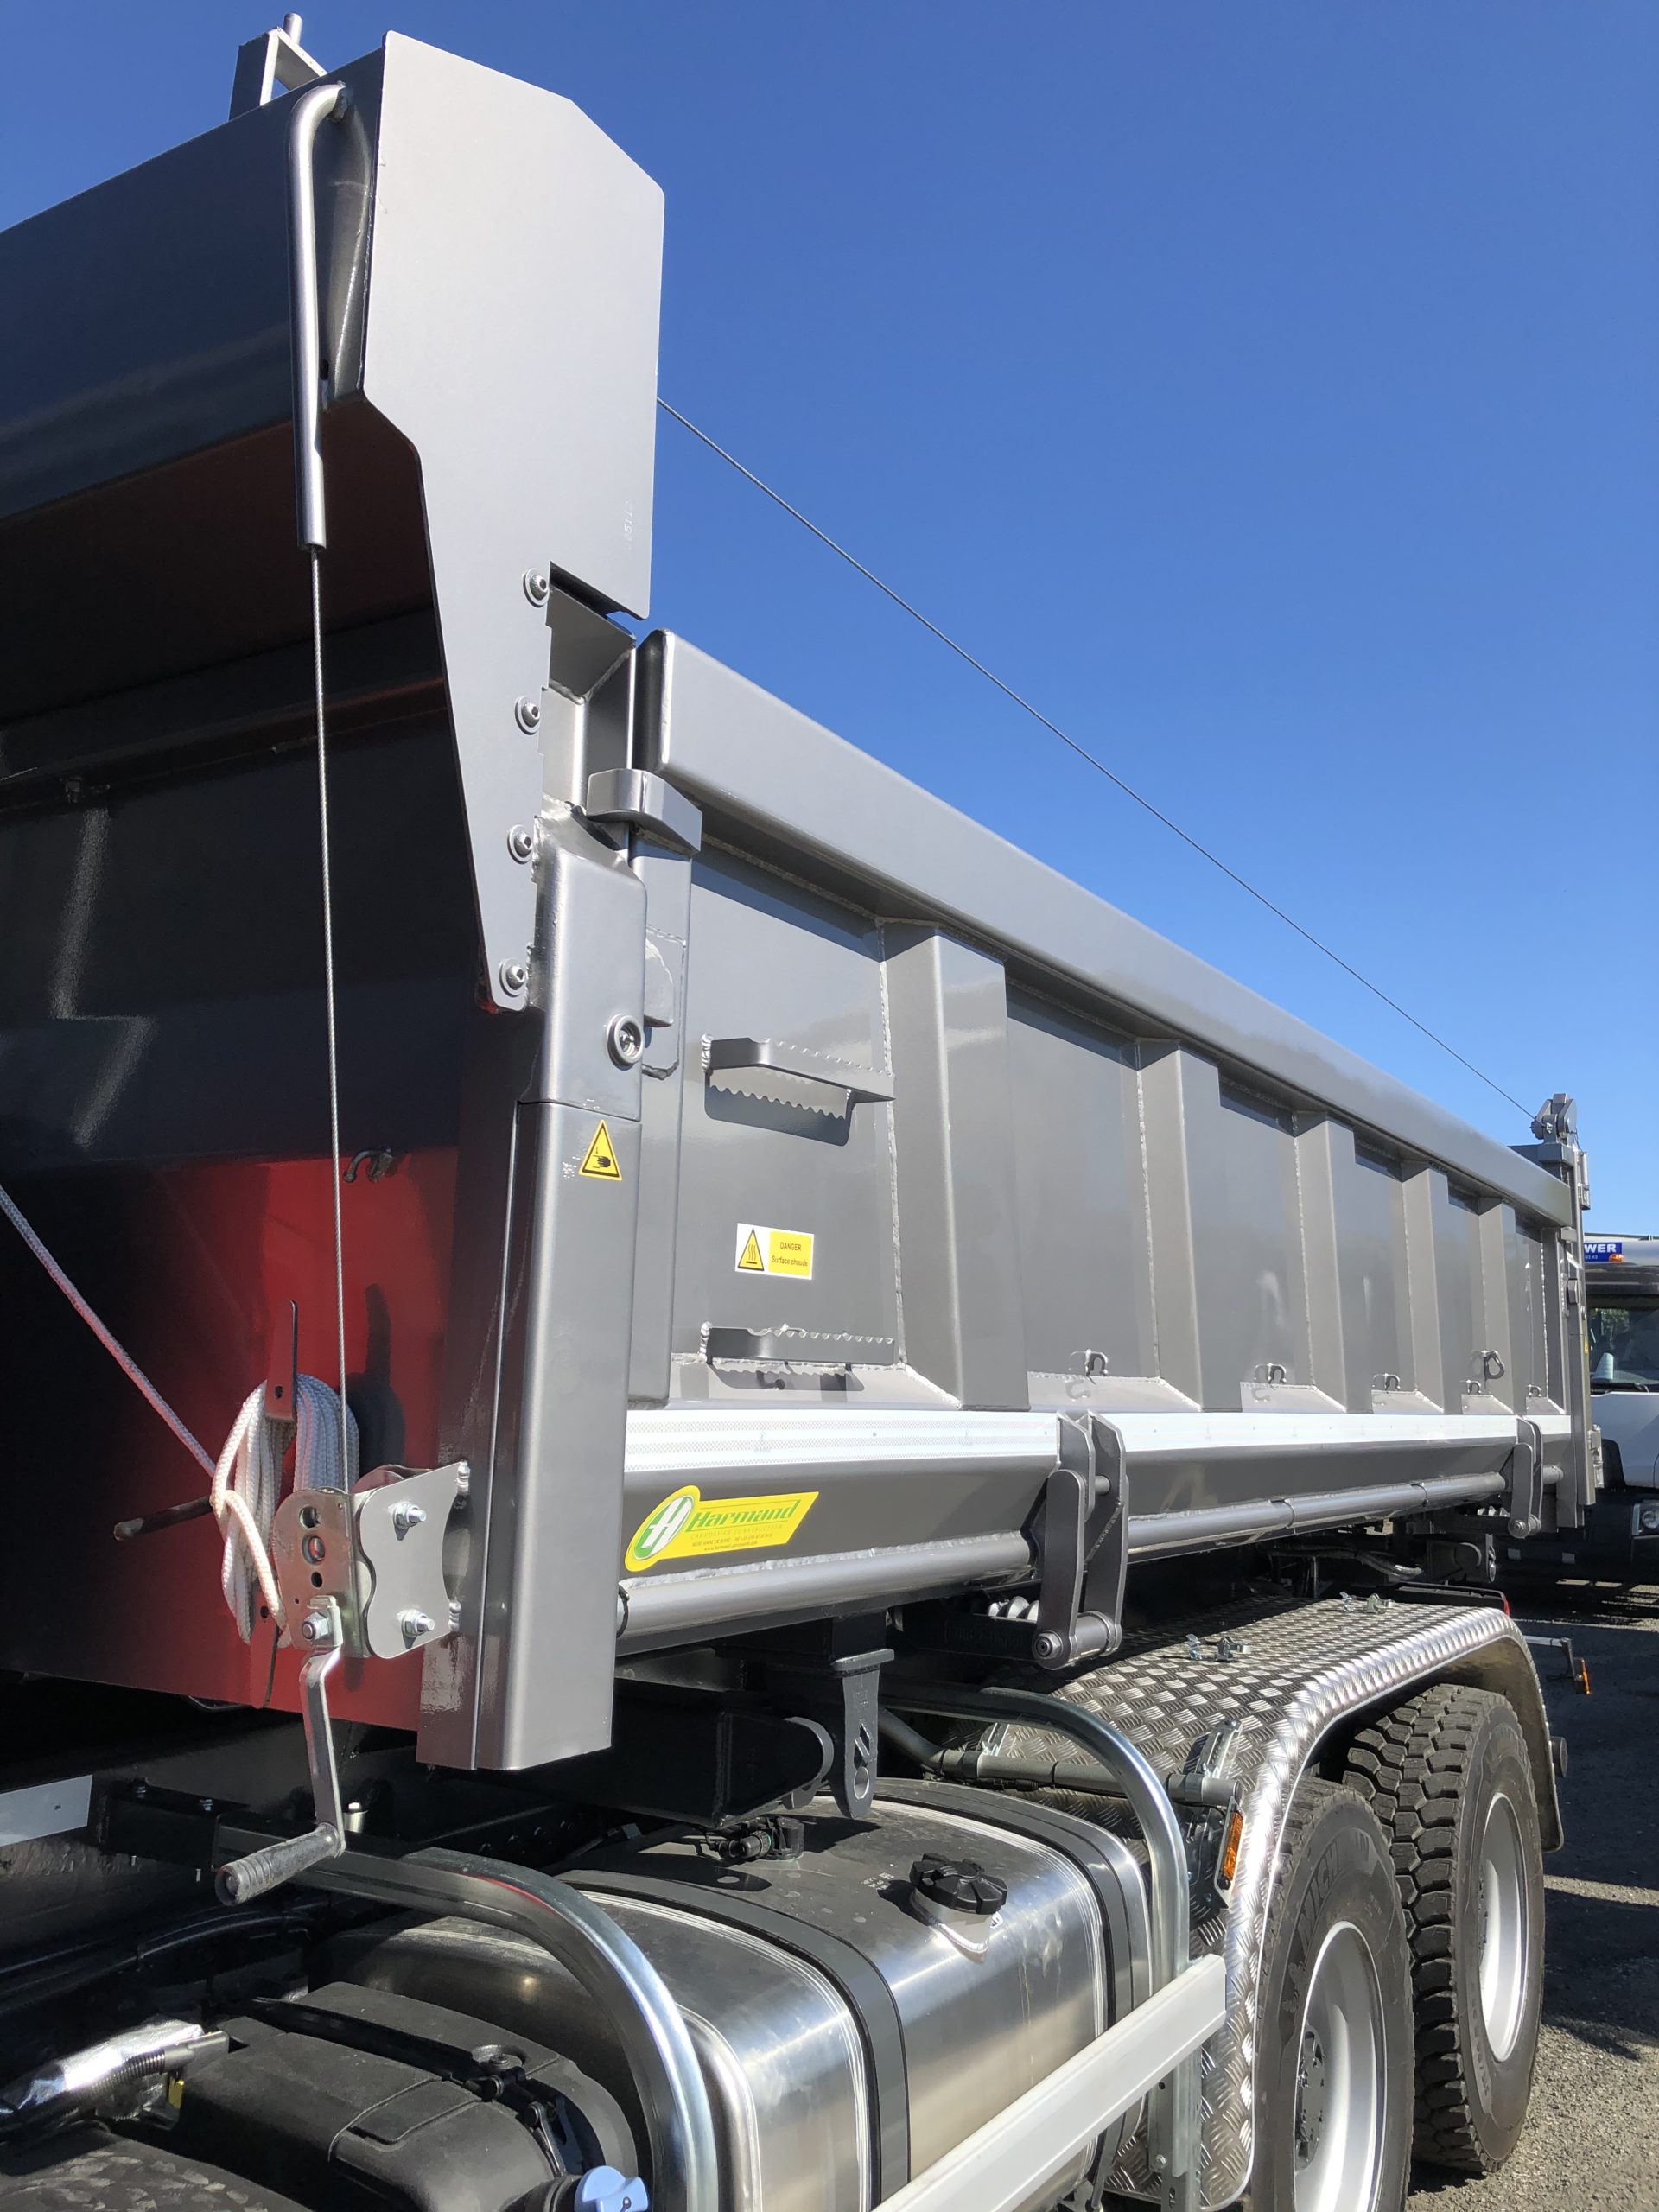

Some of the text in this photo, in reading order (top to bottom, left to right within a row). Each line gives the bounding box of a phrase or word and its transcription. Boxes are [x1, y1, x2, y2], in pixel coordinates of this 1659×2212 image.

[779, 1242, 802, 1251] DANGER
[771, 1255, 809, 1267] Surface chaude
[685, 1499, 802, 1532] Harmand
